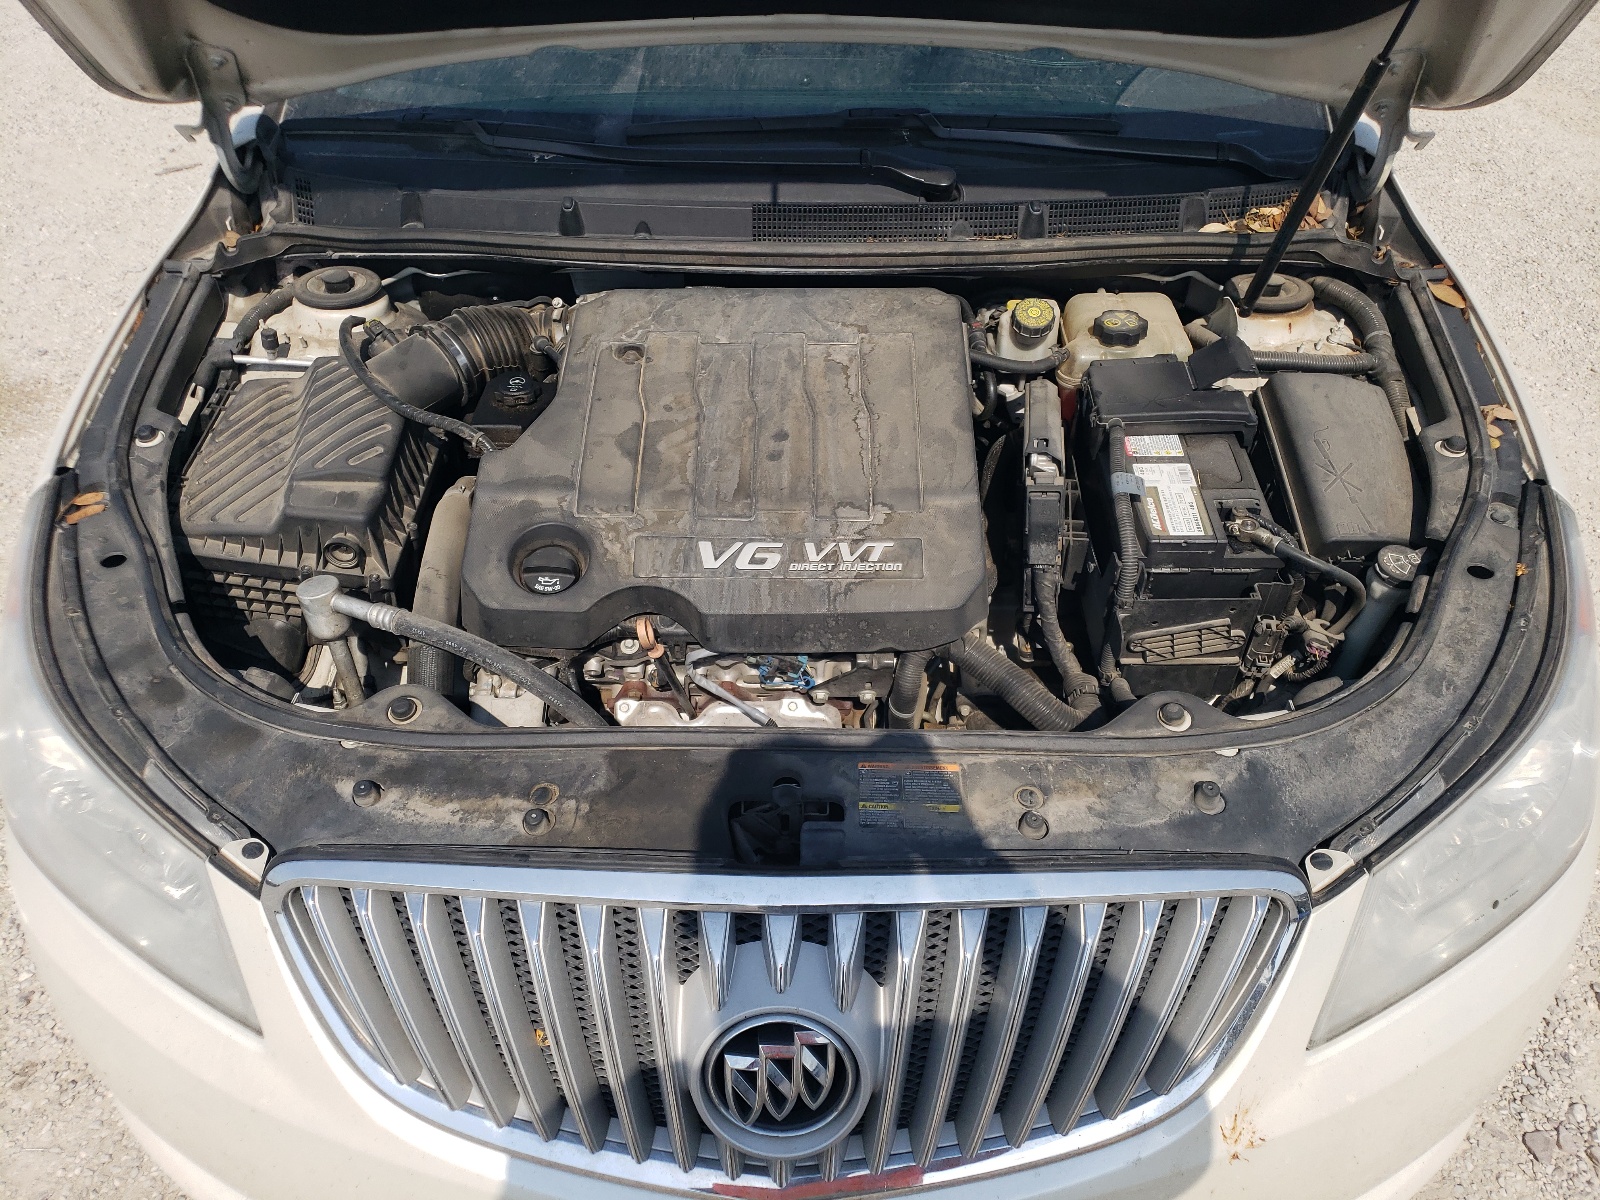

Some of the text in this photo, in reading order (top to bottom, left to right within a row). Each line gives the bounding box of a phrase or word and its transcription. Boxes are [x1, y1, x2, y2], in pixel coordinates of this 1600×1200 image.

[1146, 497, 1163, 531] ACDelco
[698, 541, 894, 570] V6 VVT
[788, 562, 903, 571] DIRECT INJECTION
